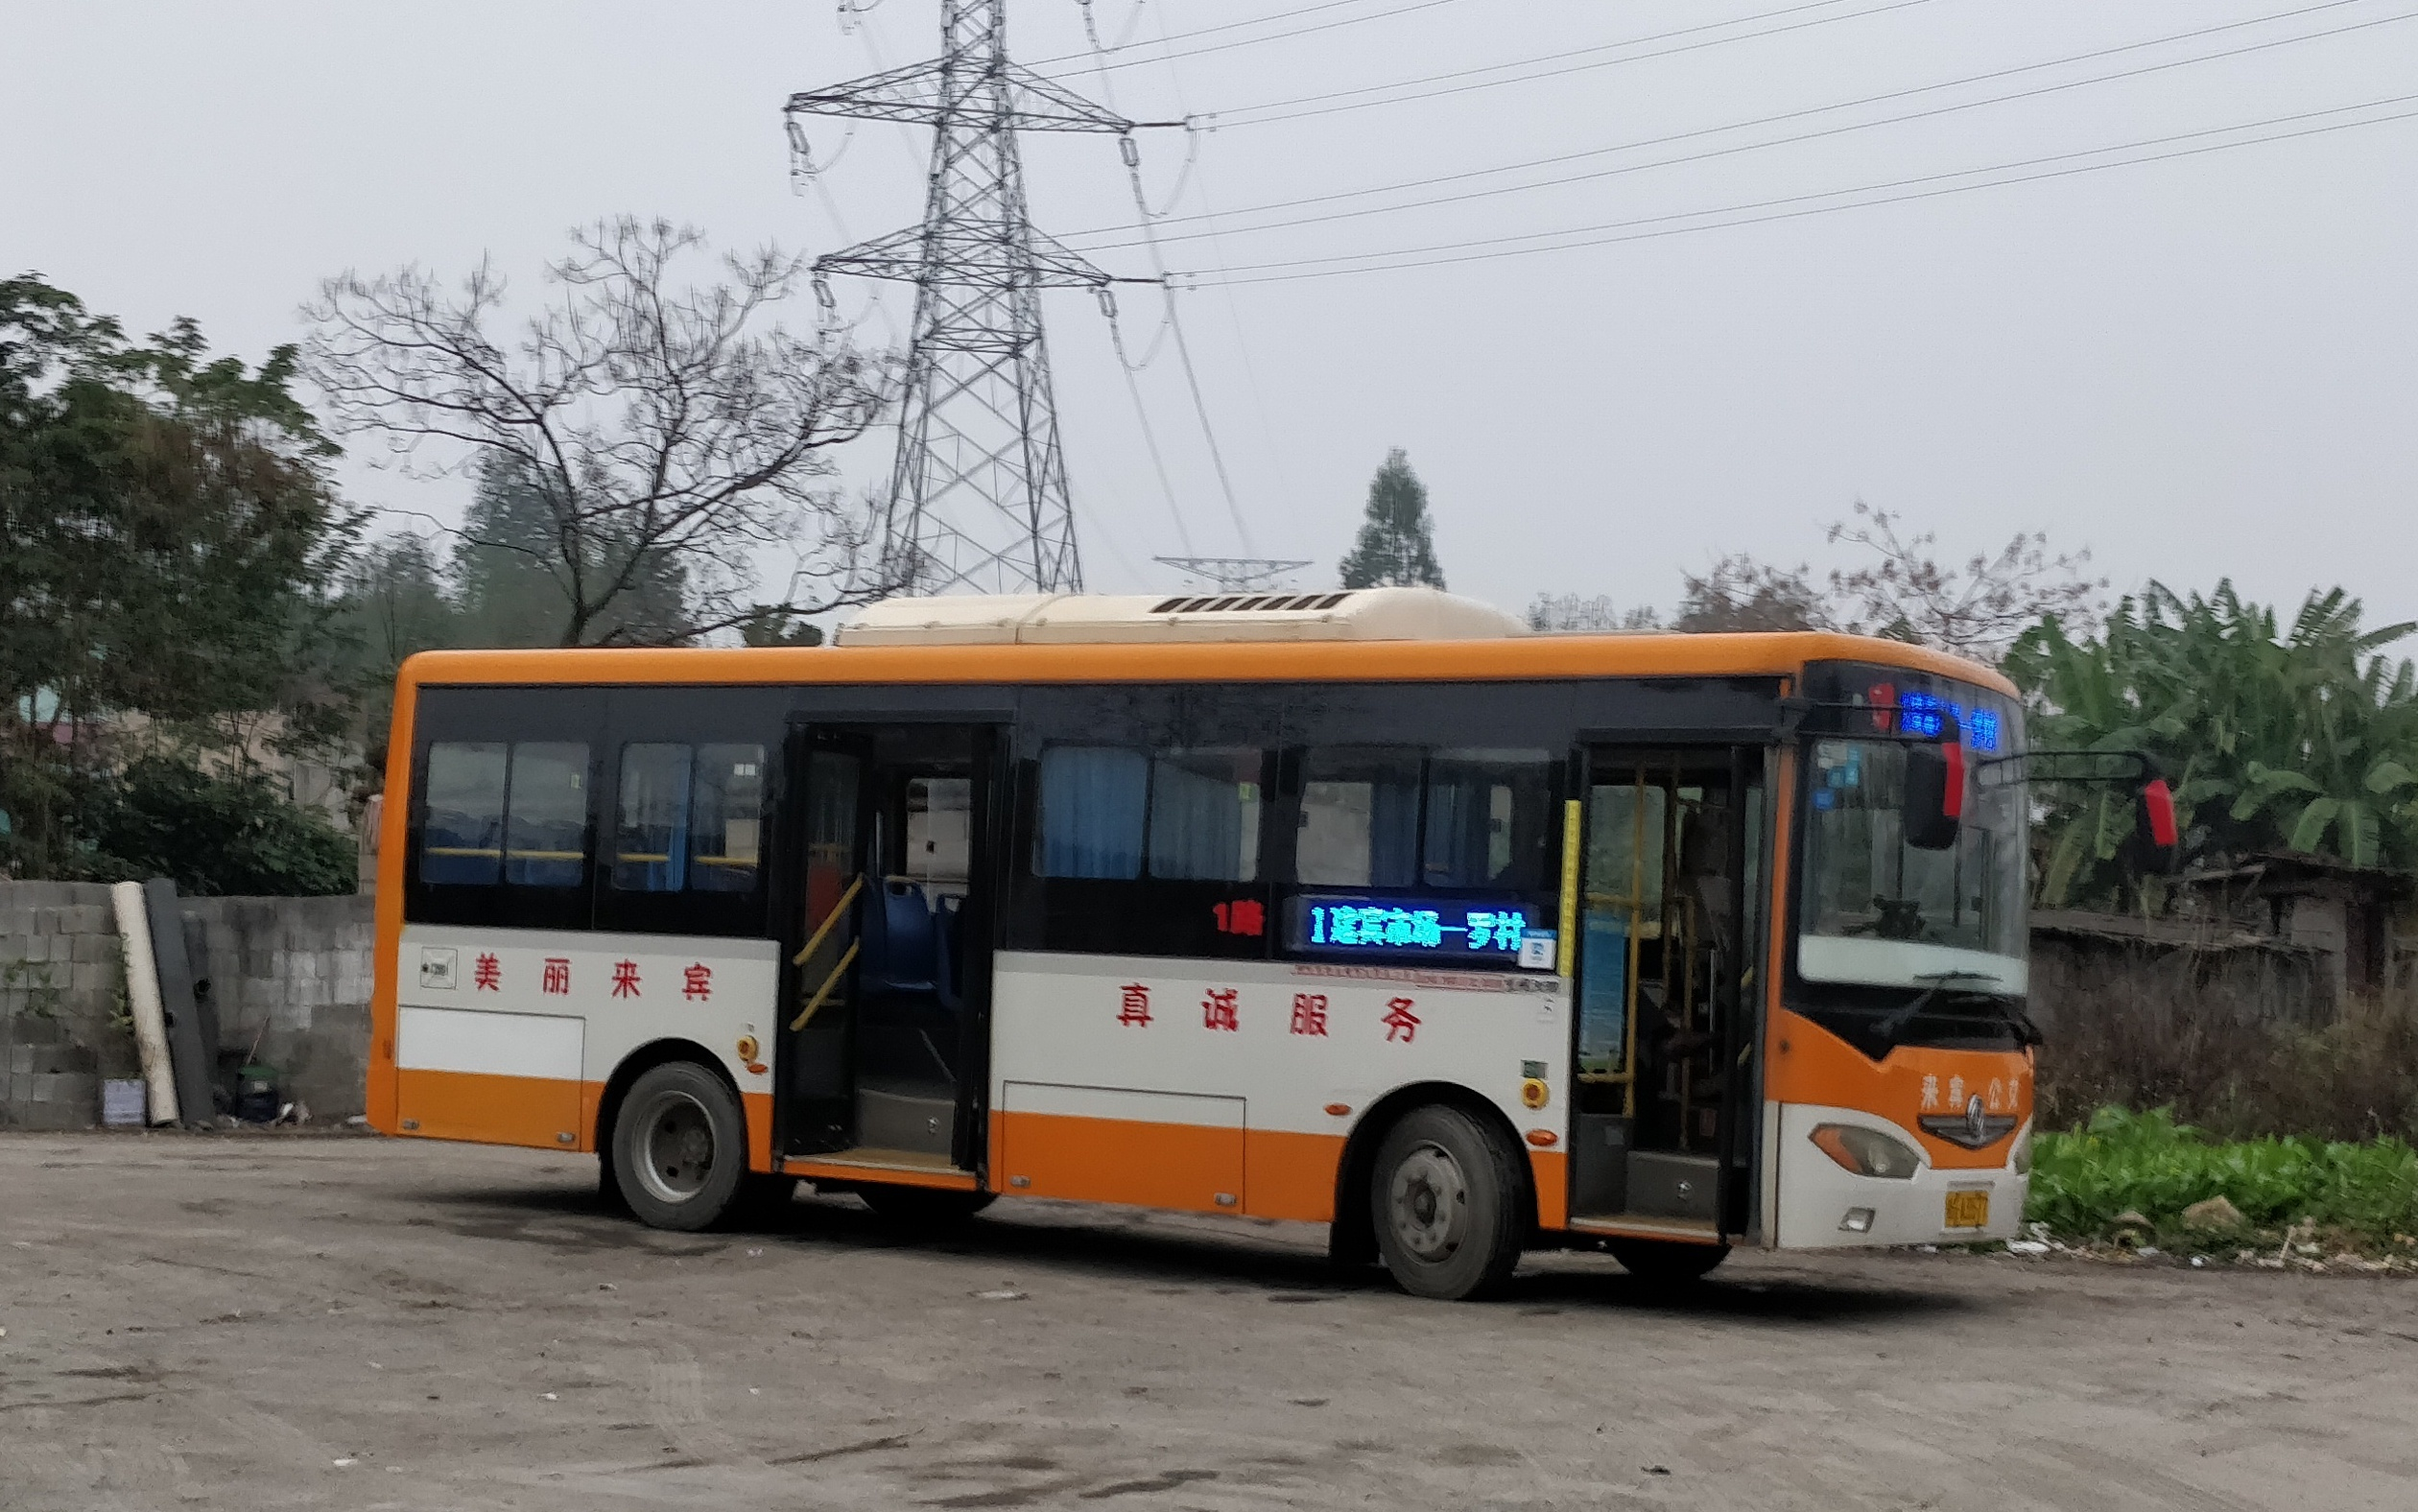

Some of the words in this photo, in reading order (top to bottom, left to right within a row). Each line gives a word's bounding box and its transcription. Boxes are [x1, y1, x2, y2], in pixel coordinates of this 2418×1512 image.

[474, 952, 714, 1002] 美丽来宾
[1116, 982, 1423, 1043] 真诚服务
